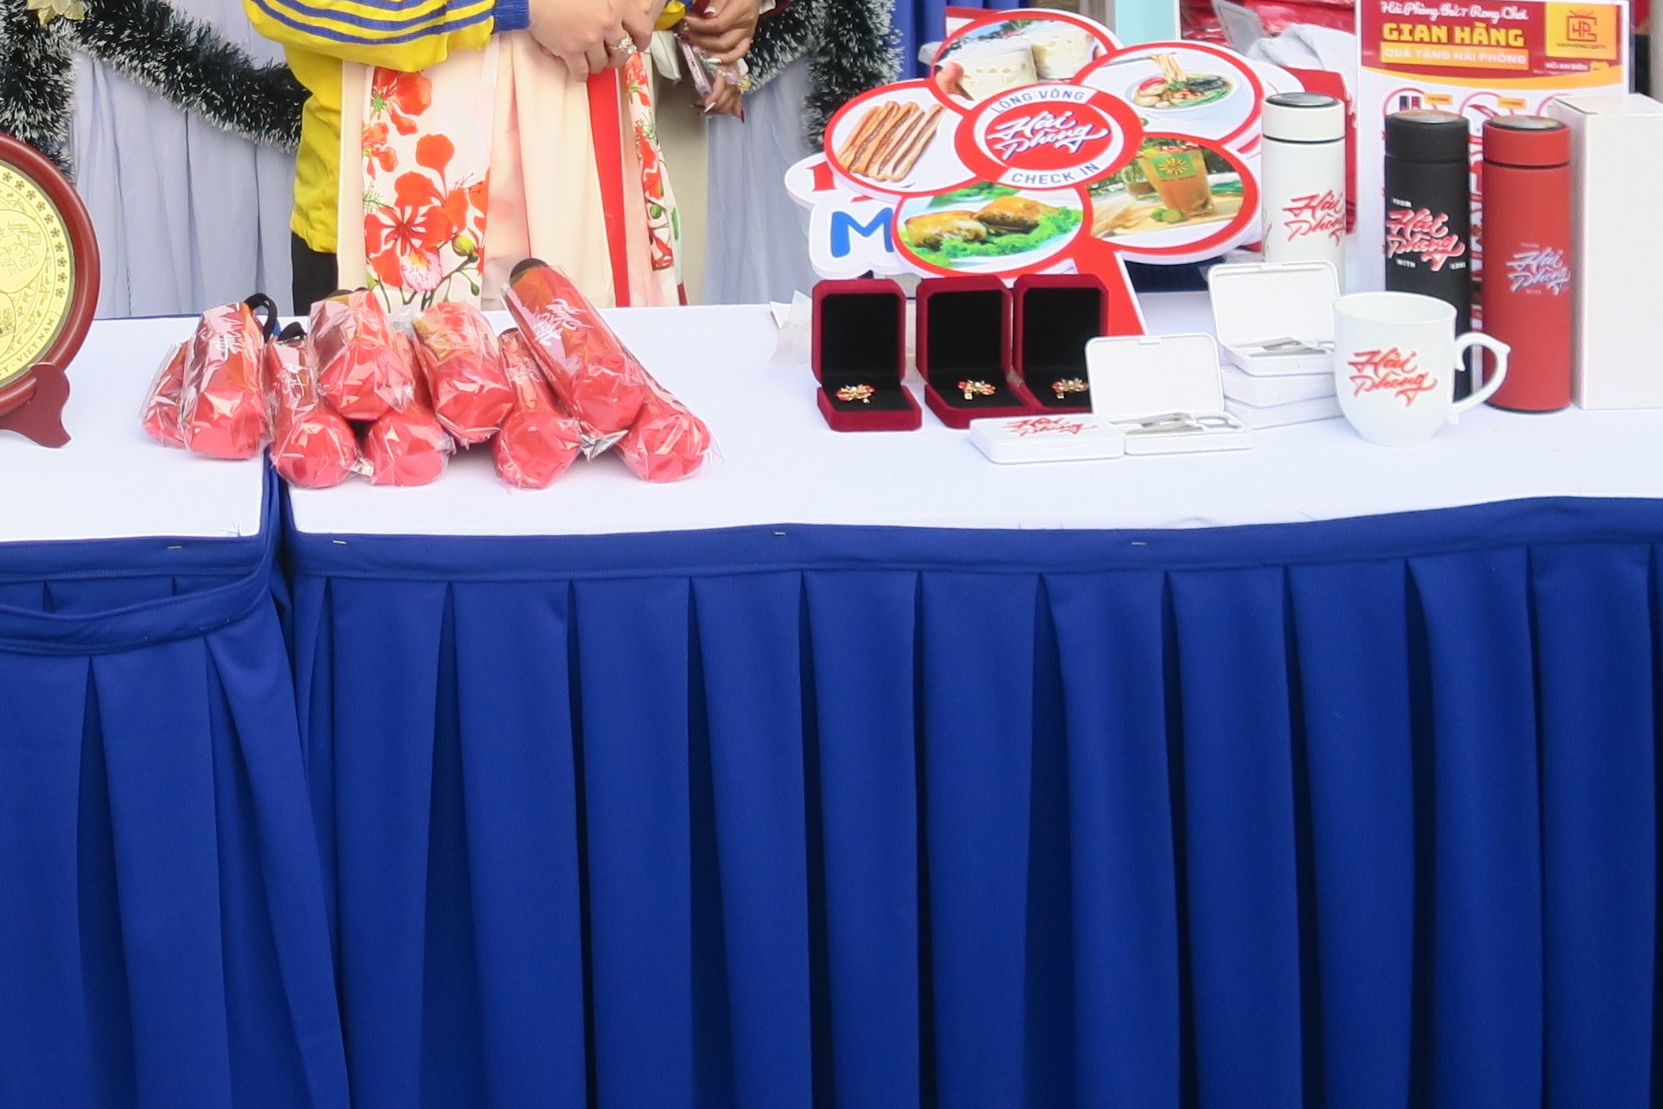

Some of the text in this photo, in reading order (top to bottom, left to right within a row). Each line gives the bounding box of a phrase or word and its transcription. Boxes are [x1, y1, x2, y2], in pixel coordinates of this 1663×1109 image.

[1382, 21, 1525, 47] GIAN HÀNG
[990, 87, 1086, 114] LÒNG VÒNG
[986, 110, 1078, 141] Hải
[993, 123, 1112, 161] Phòng
[1010, 162, 1101, 185] CHECK IN
